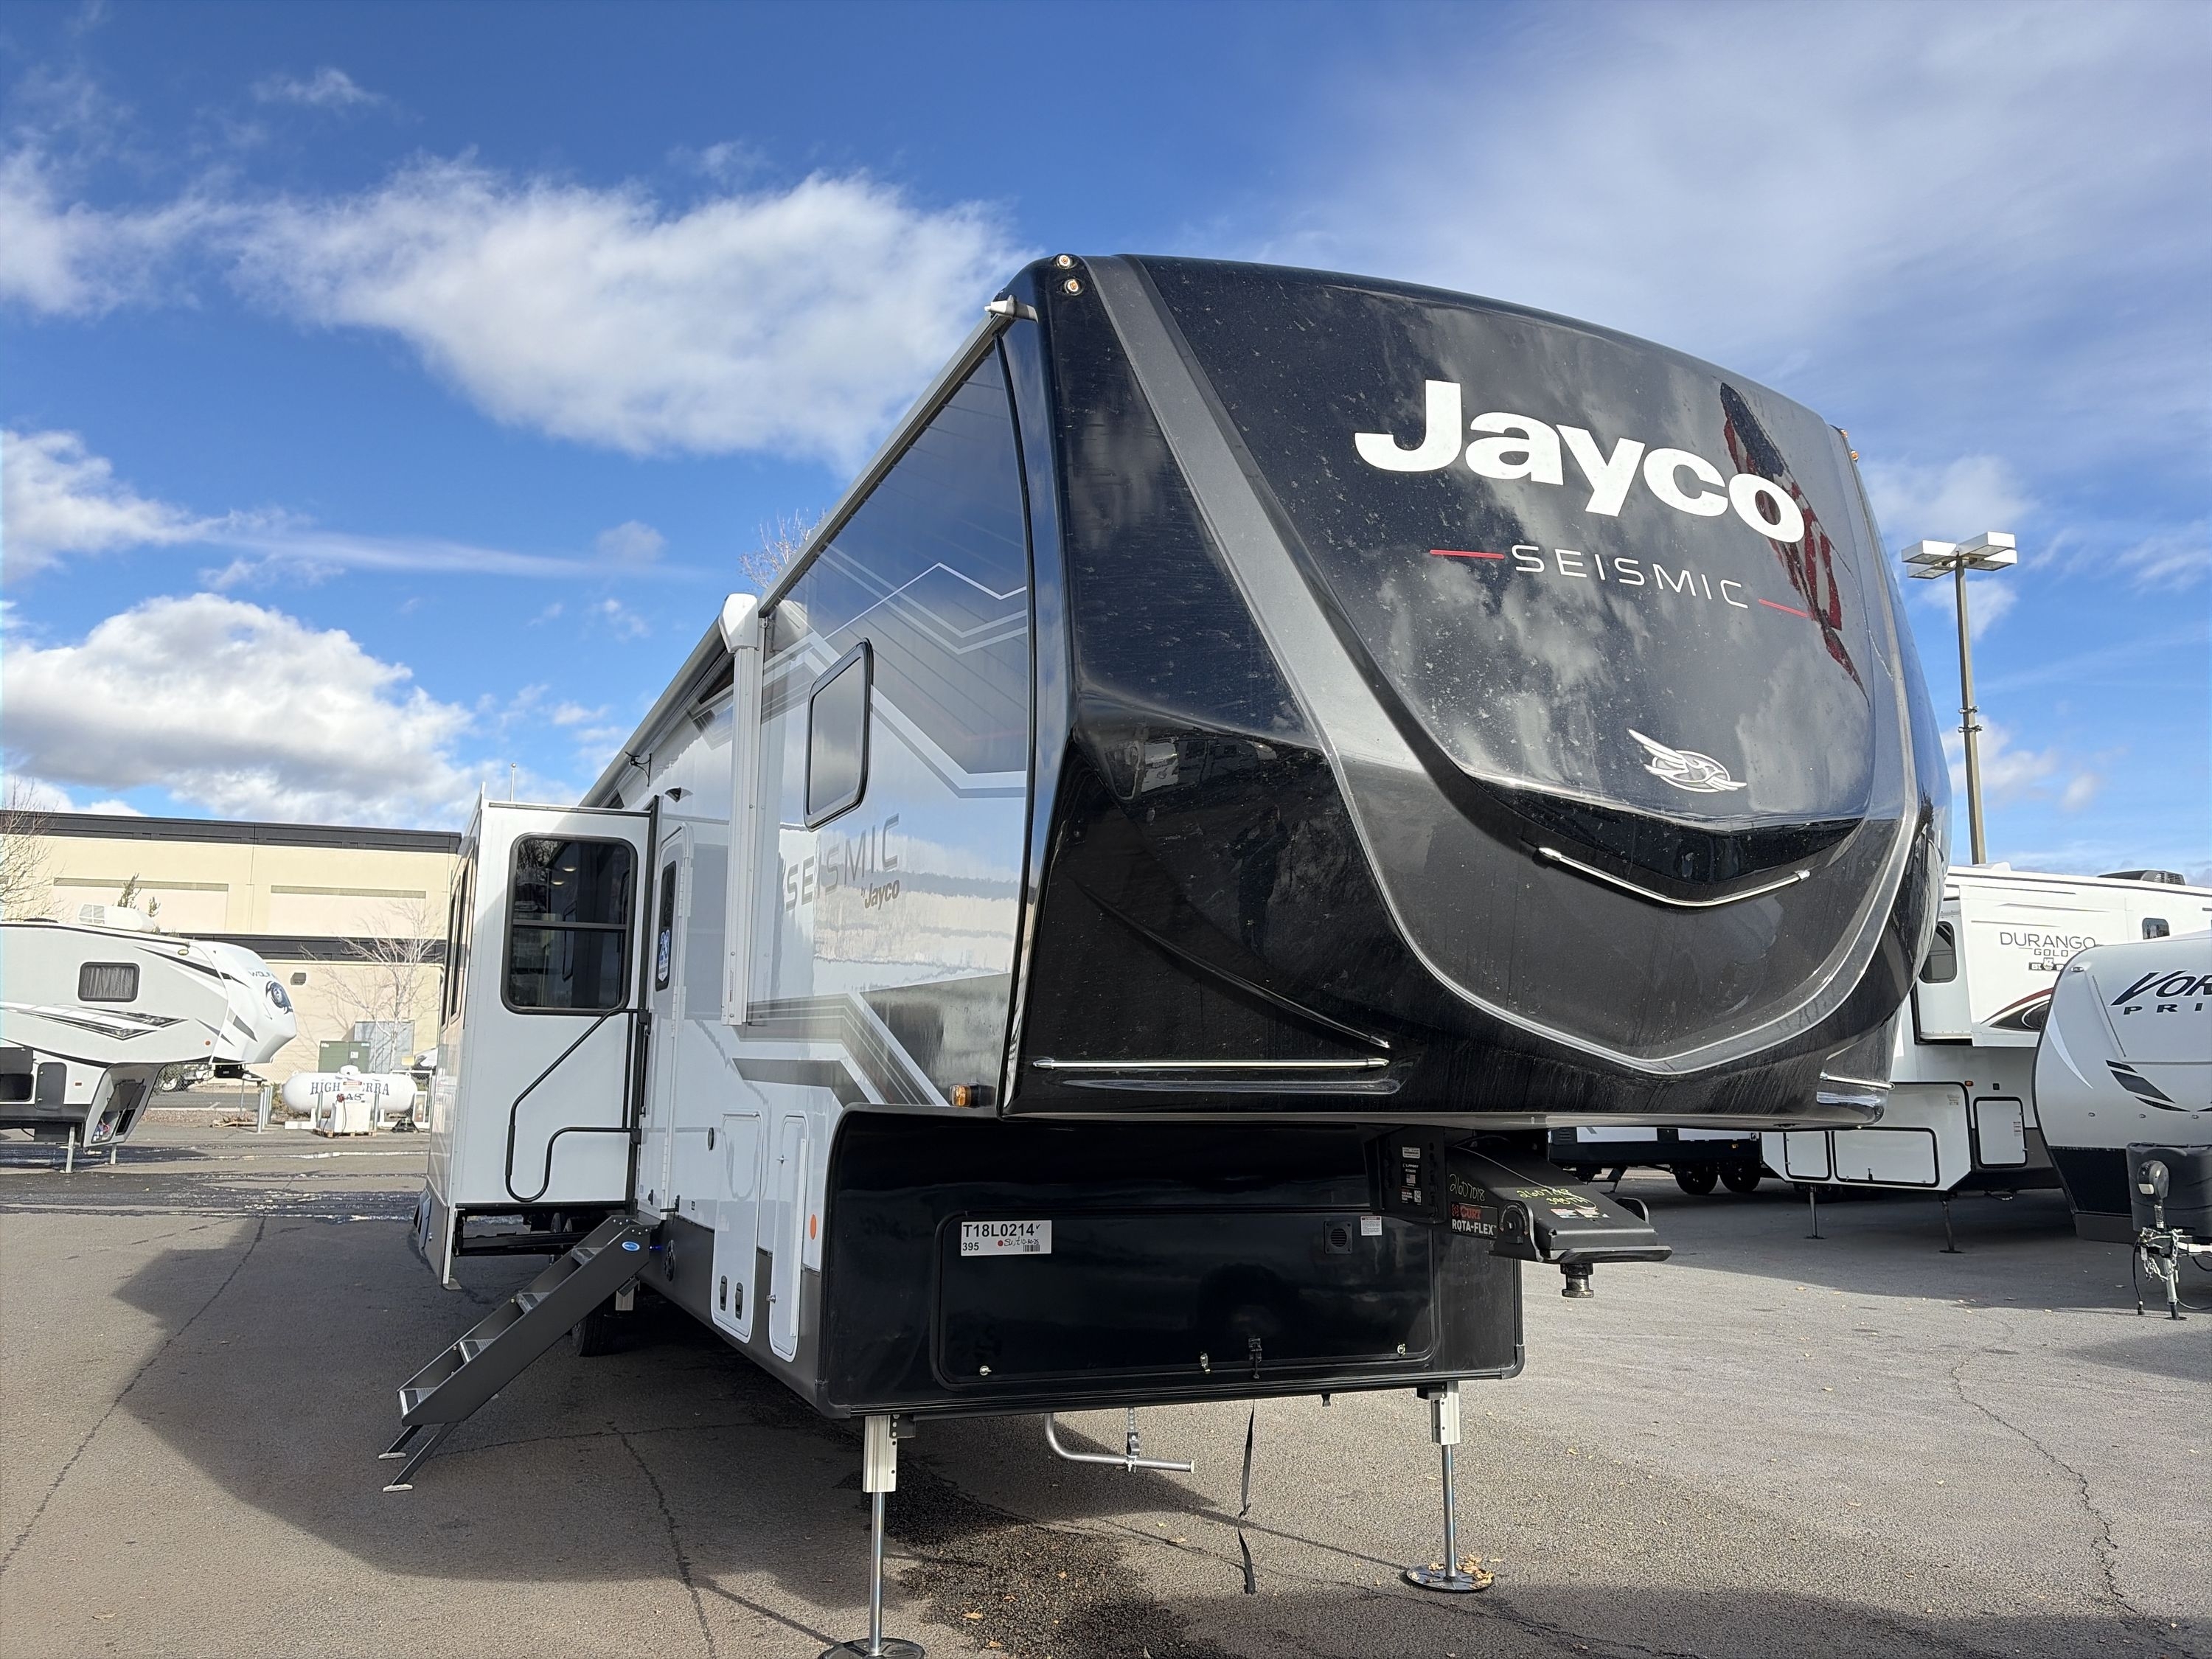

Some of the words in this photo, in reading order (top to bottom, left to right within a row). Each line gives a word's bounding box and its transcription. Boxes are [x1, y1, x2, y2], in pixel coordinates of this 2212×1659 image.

[1354, 380, 1804, 543] Jayco
[1512, 544, 1748, 609] SEISMIC
[786, 813, 899, 911] SEISMIC
[865, 880, 900, 910] Jayco
[2000, 932, 2096, 950] DURANGO
[2034, 948, 2068, 957] GOLD
[2124, 1002, 2203, 1015] PRI
[310, 1082, 341, 1095] HIGH
[962, 1223, 1034, 1237] T18L0214
[962, 1242, 979, 1251] 395
